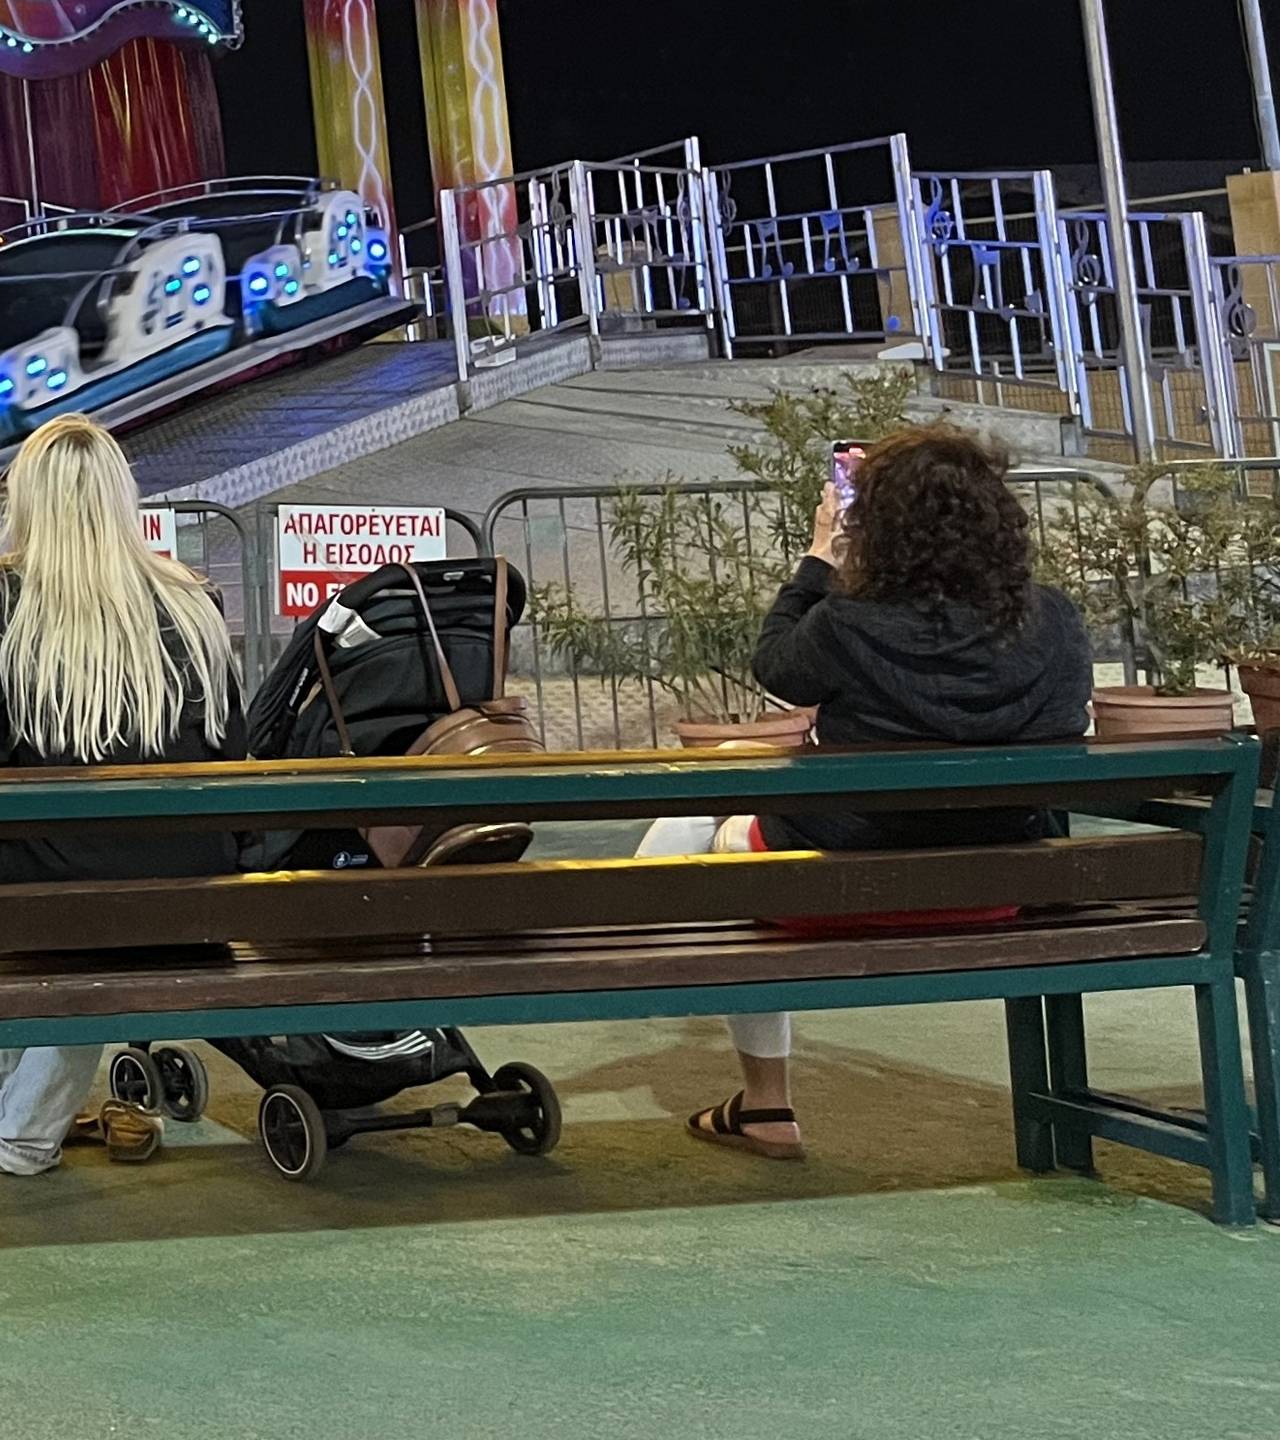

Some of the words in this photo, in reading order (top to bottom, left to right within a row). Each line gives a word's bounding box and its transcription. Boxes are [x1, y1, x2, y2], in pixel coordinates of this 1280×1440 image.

[284, 513, 441, 537] ΑΠΑΓΟΡΕΥΕΤΑΙ
[304, 543, 317, 564] Η
[326, 543, 416, 565] ΕΙΣΟΔΟΣ
[286, 582, 320, 607] NO
